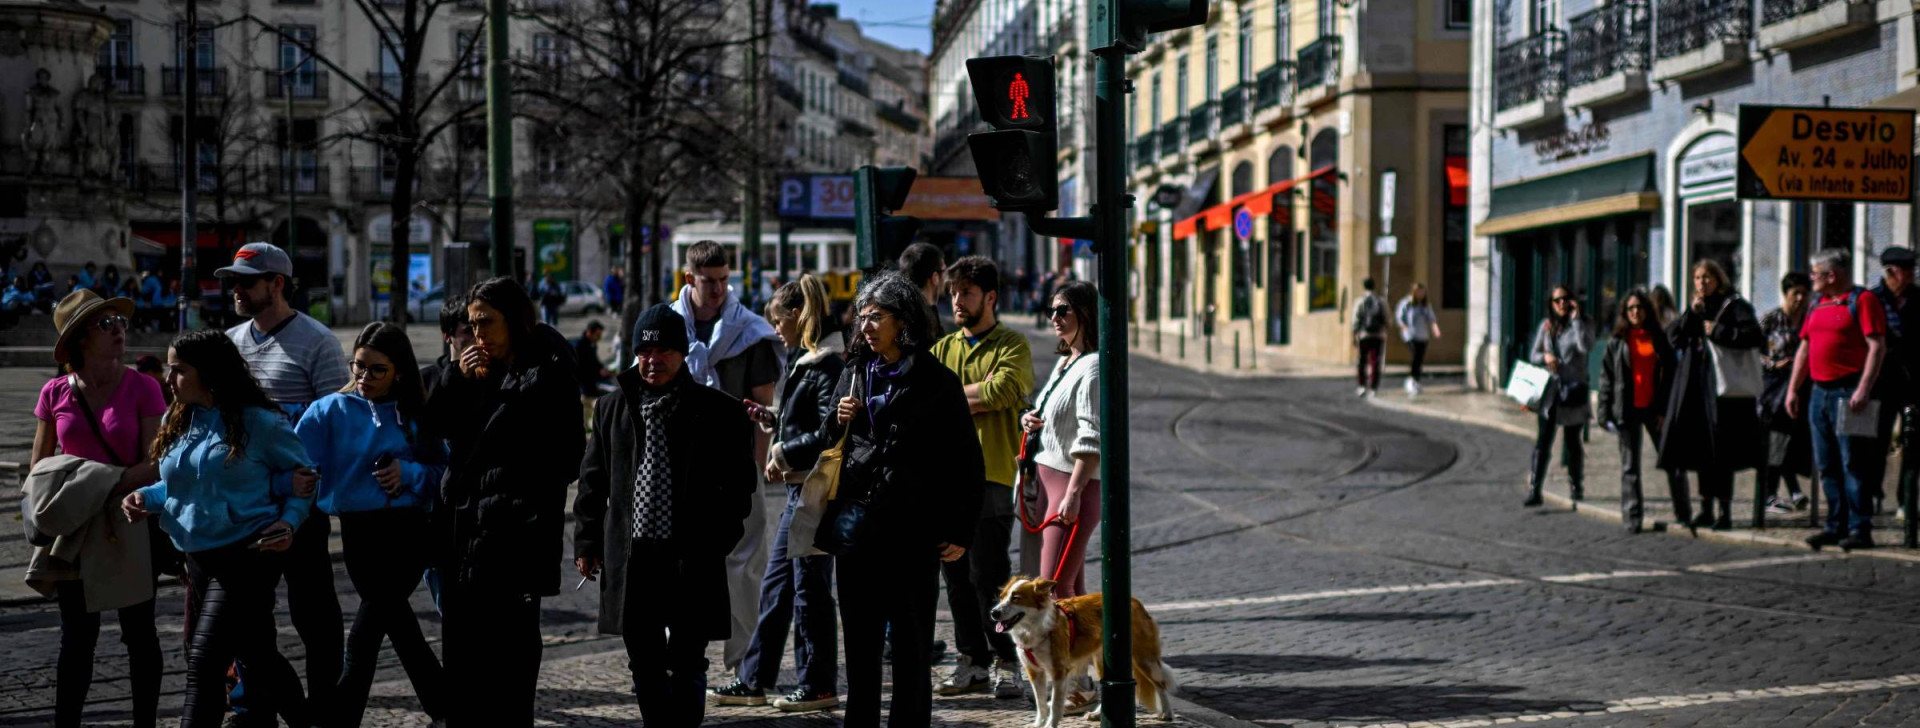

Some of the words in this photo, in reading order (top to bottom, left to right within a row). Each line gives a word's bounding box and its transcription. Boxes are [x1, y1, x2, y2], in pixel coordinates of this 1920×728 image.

[1792, 114, 1895, 142] Desvio
[1777, 146, 1805, 168] Av.
[1813, 146, 1836, 168] 24
[1861, 148, 1908, 170] Julho
[781, 179, 804, 211] P
[1778, 174, 1803, 191] (via
[1809, 174, 1854, 193] Infante
[1861, 176, 1905, 195] Santo)
